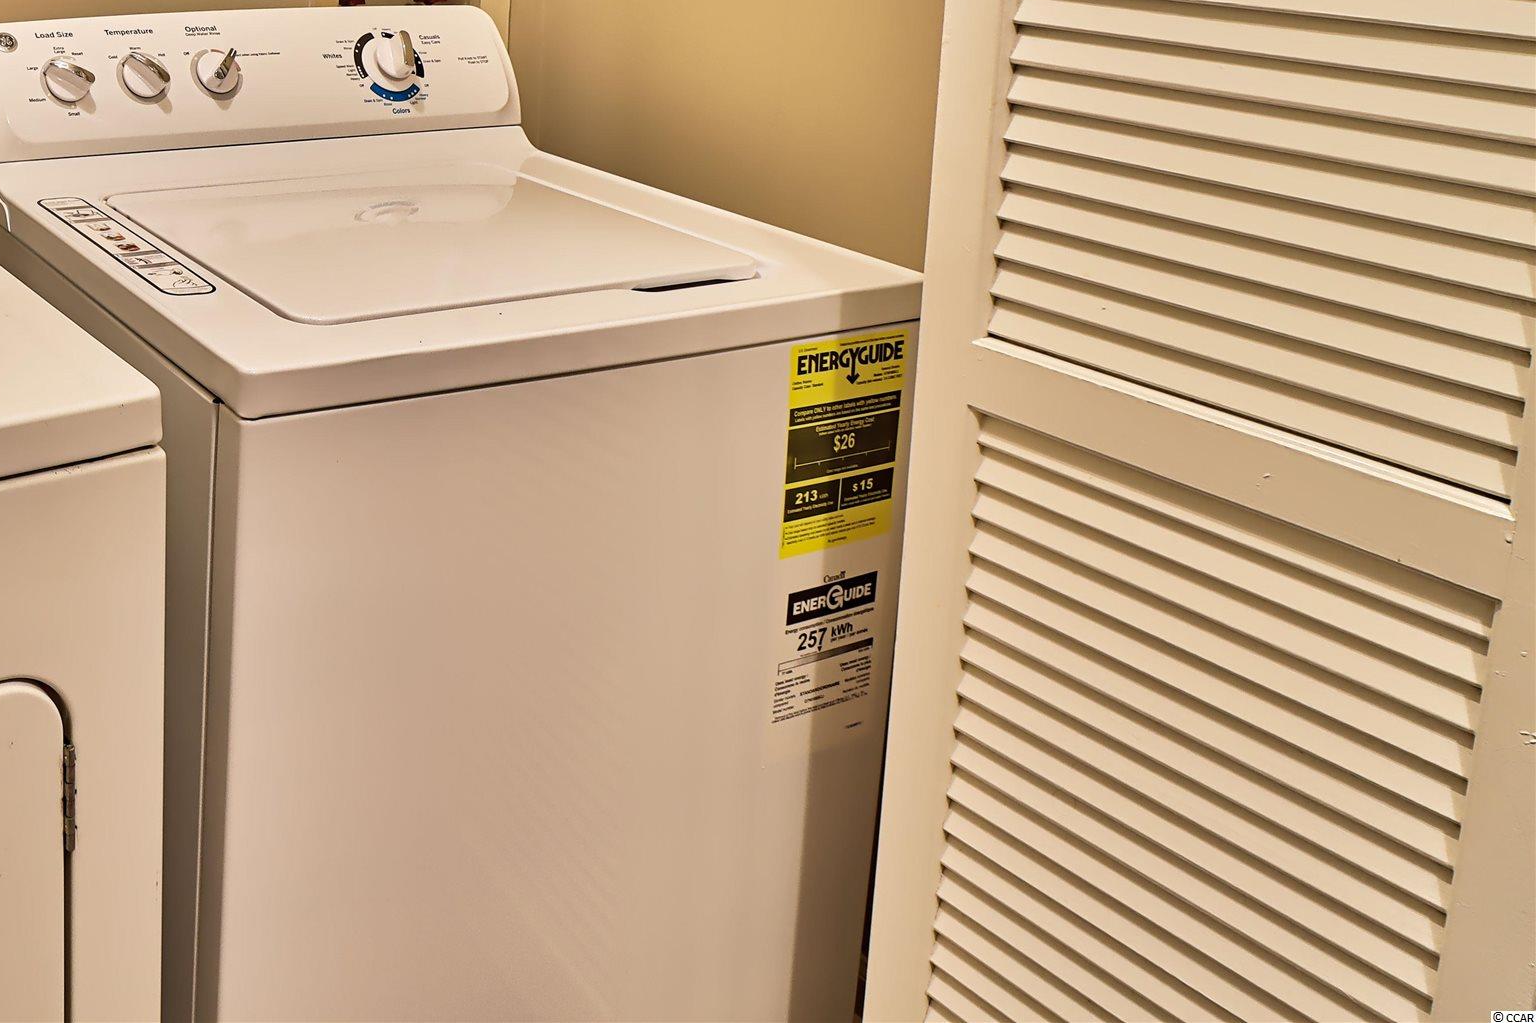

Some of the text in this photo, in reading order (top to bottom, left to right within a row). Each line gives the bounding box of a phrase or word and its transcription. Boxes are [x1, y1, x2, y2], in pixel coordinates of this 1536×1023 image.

[104, 28, 154, 36] Temperature
[184, 25, 217, 33] Optional
[797, 340, 905, 376] ENERGYGUIDE
[794, 409, 814, 418] Compare
[816, 424, 836, 432] Estimated
[834, 432, 856, 452] $26
[795, 490, 818, 505] 213
[792, 582, 872, 616] ENERGUIDE
[797, 622, 854, 652] 257 kWh
